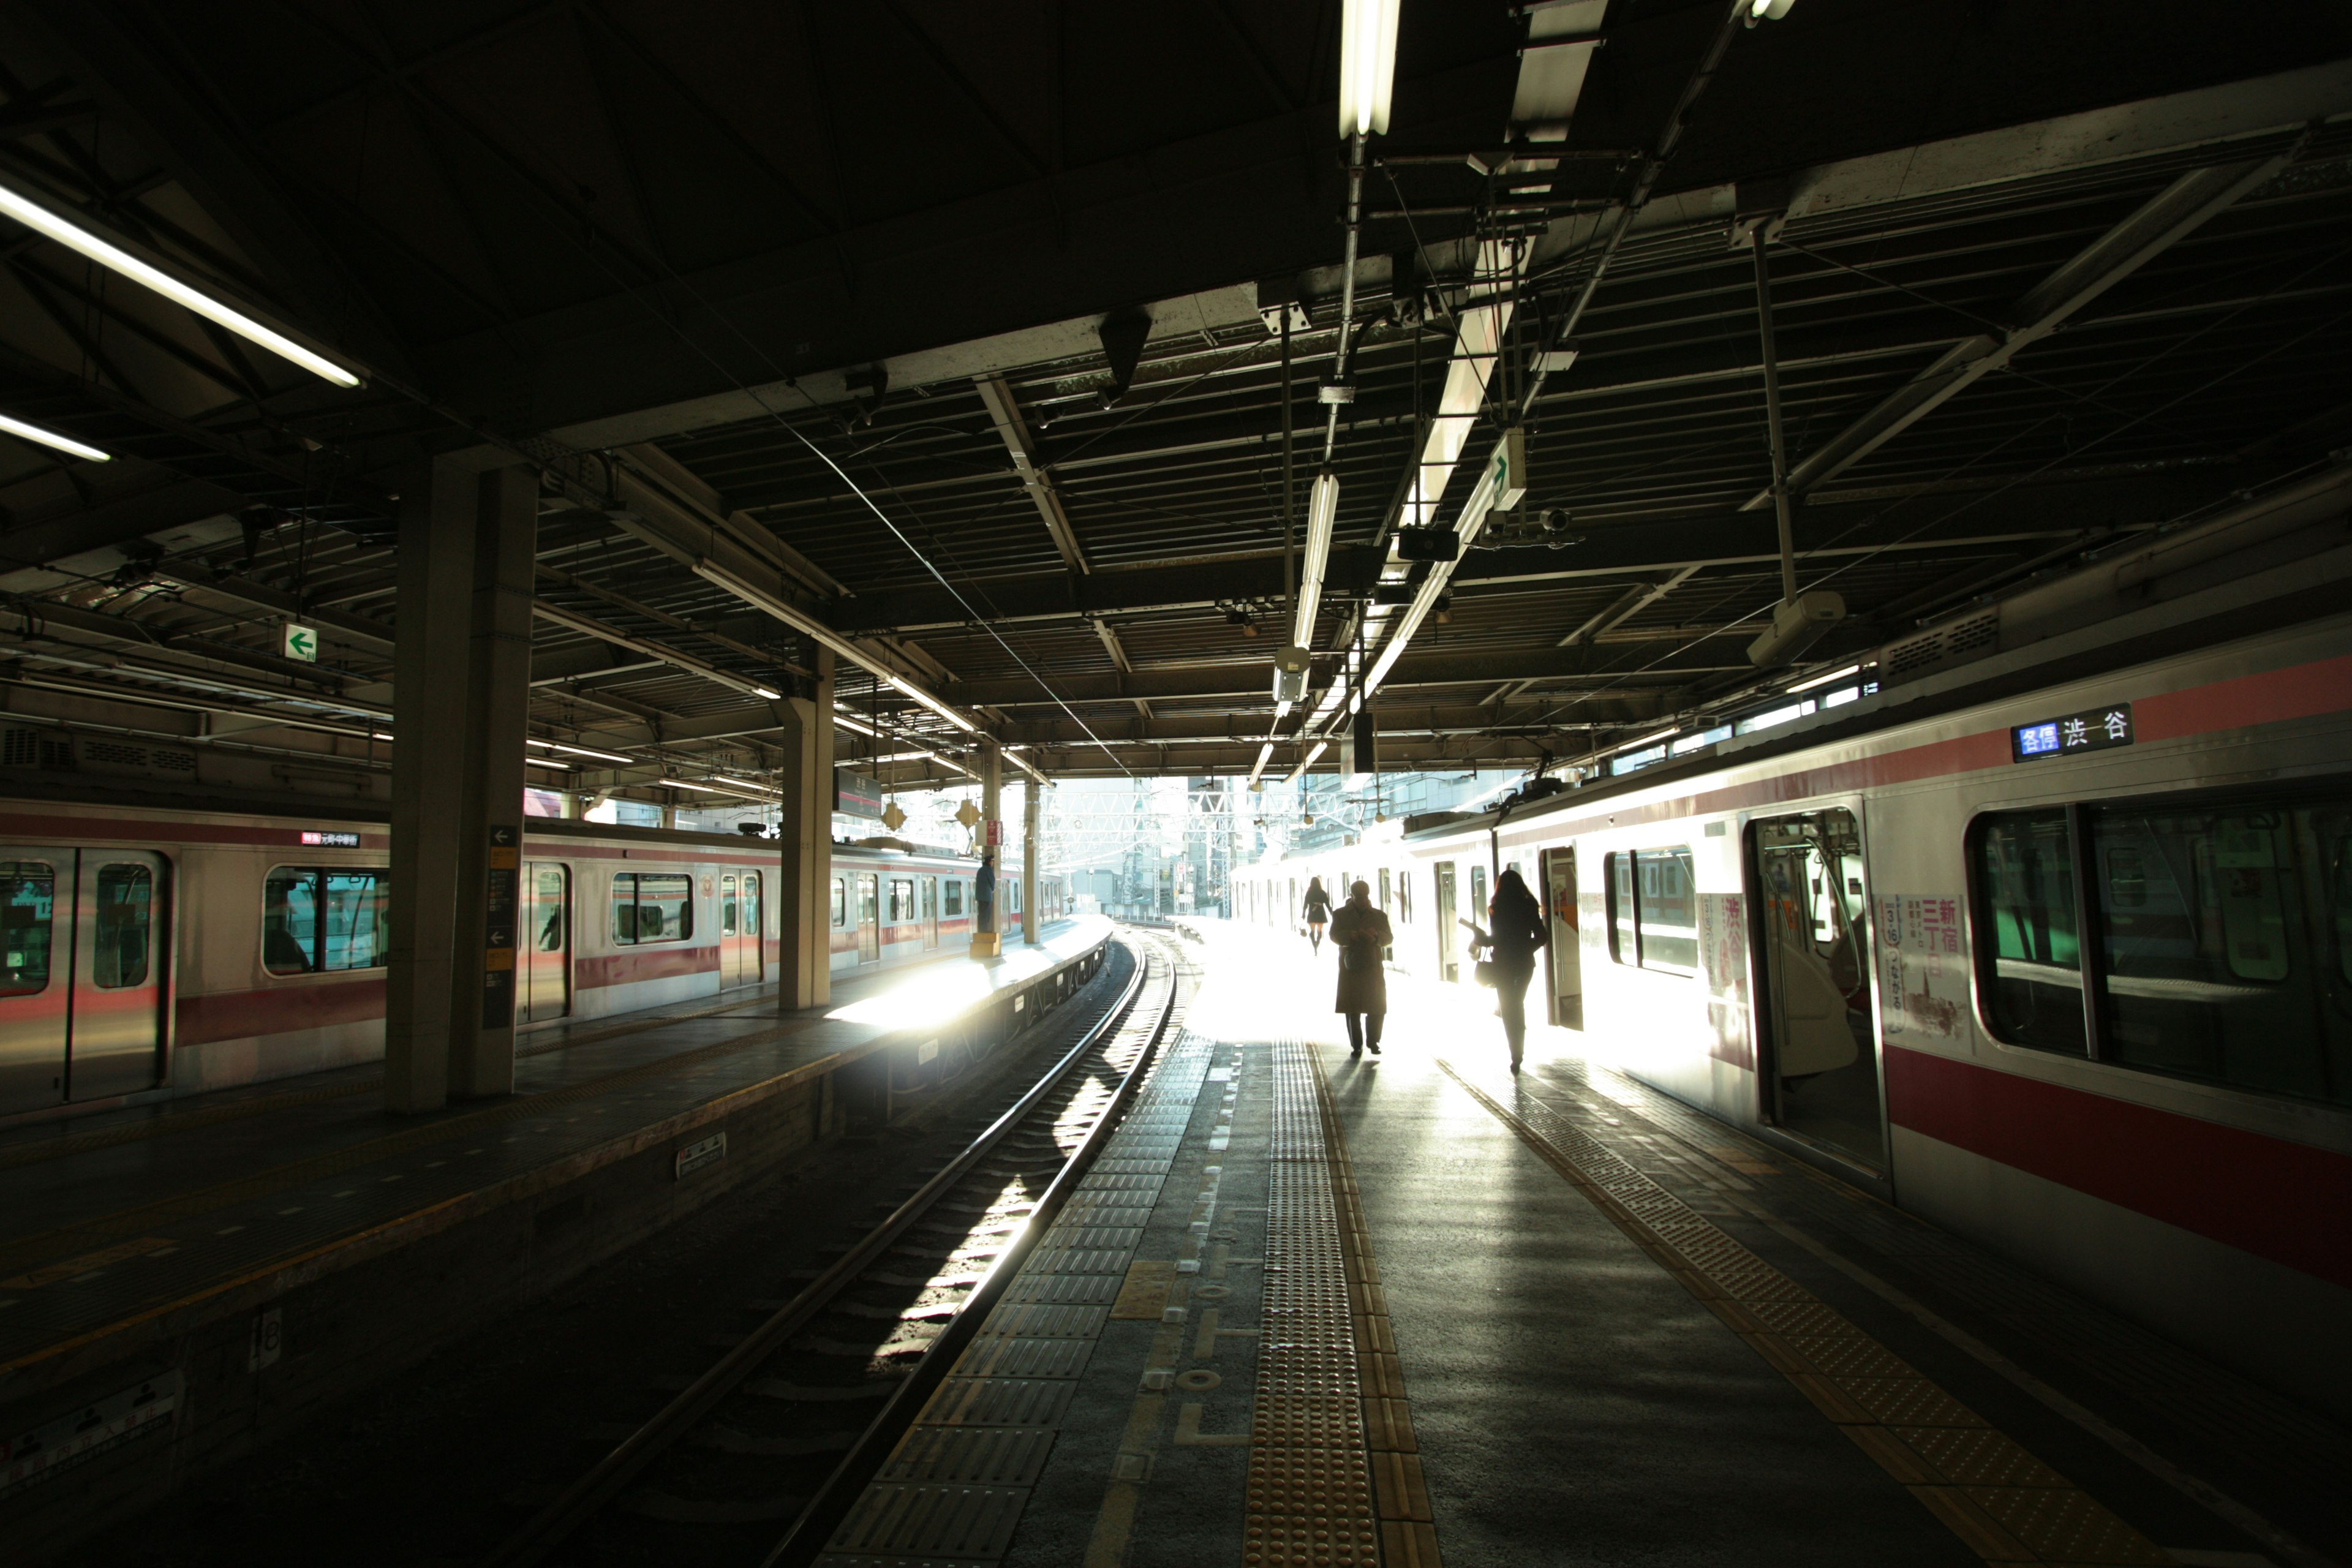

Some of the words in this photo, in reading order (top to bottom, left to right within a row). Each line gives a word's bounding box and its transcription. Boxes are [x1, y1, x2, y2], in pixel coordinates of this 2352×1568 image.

[2022, 726, 2059, 752] 各停
[1726, 897, 1743, 962] 渋谷
[1922, 900, 1941, 978] 三丁目
[1939, 899, 1958, 952] 新宿
